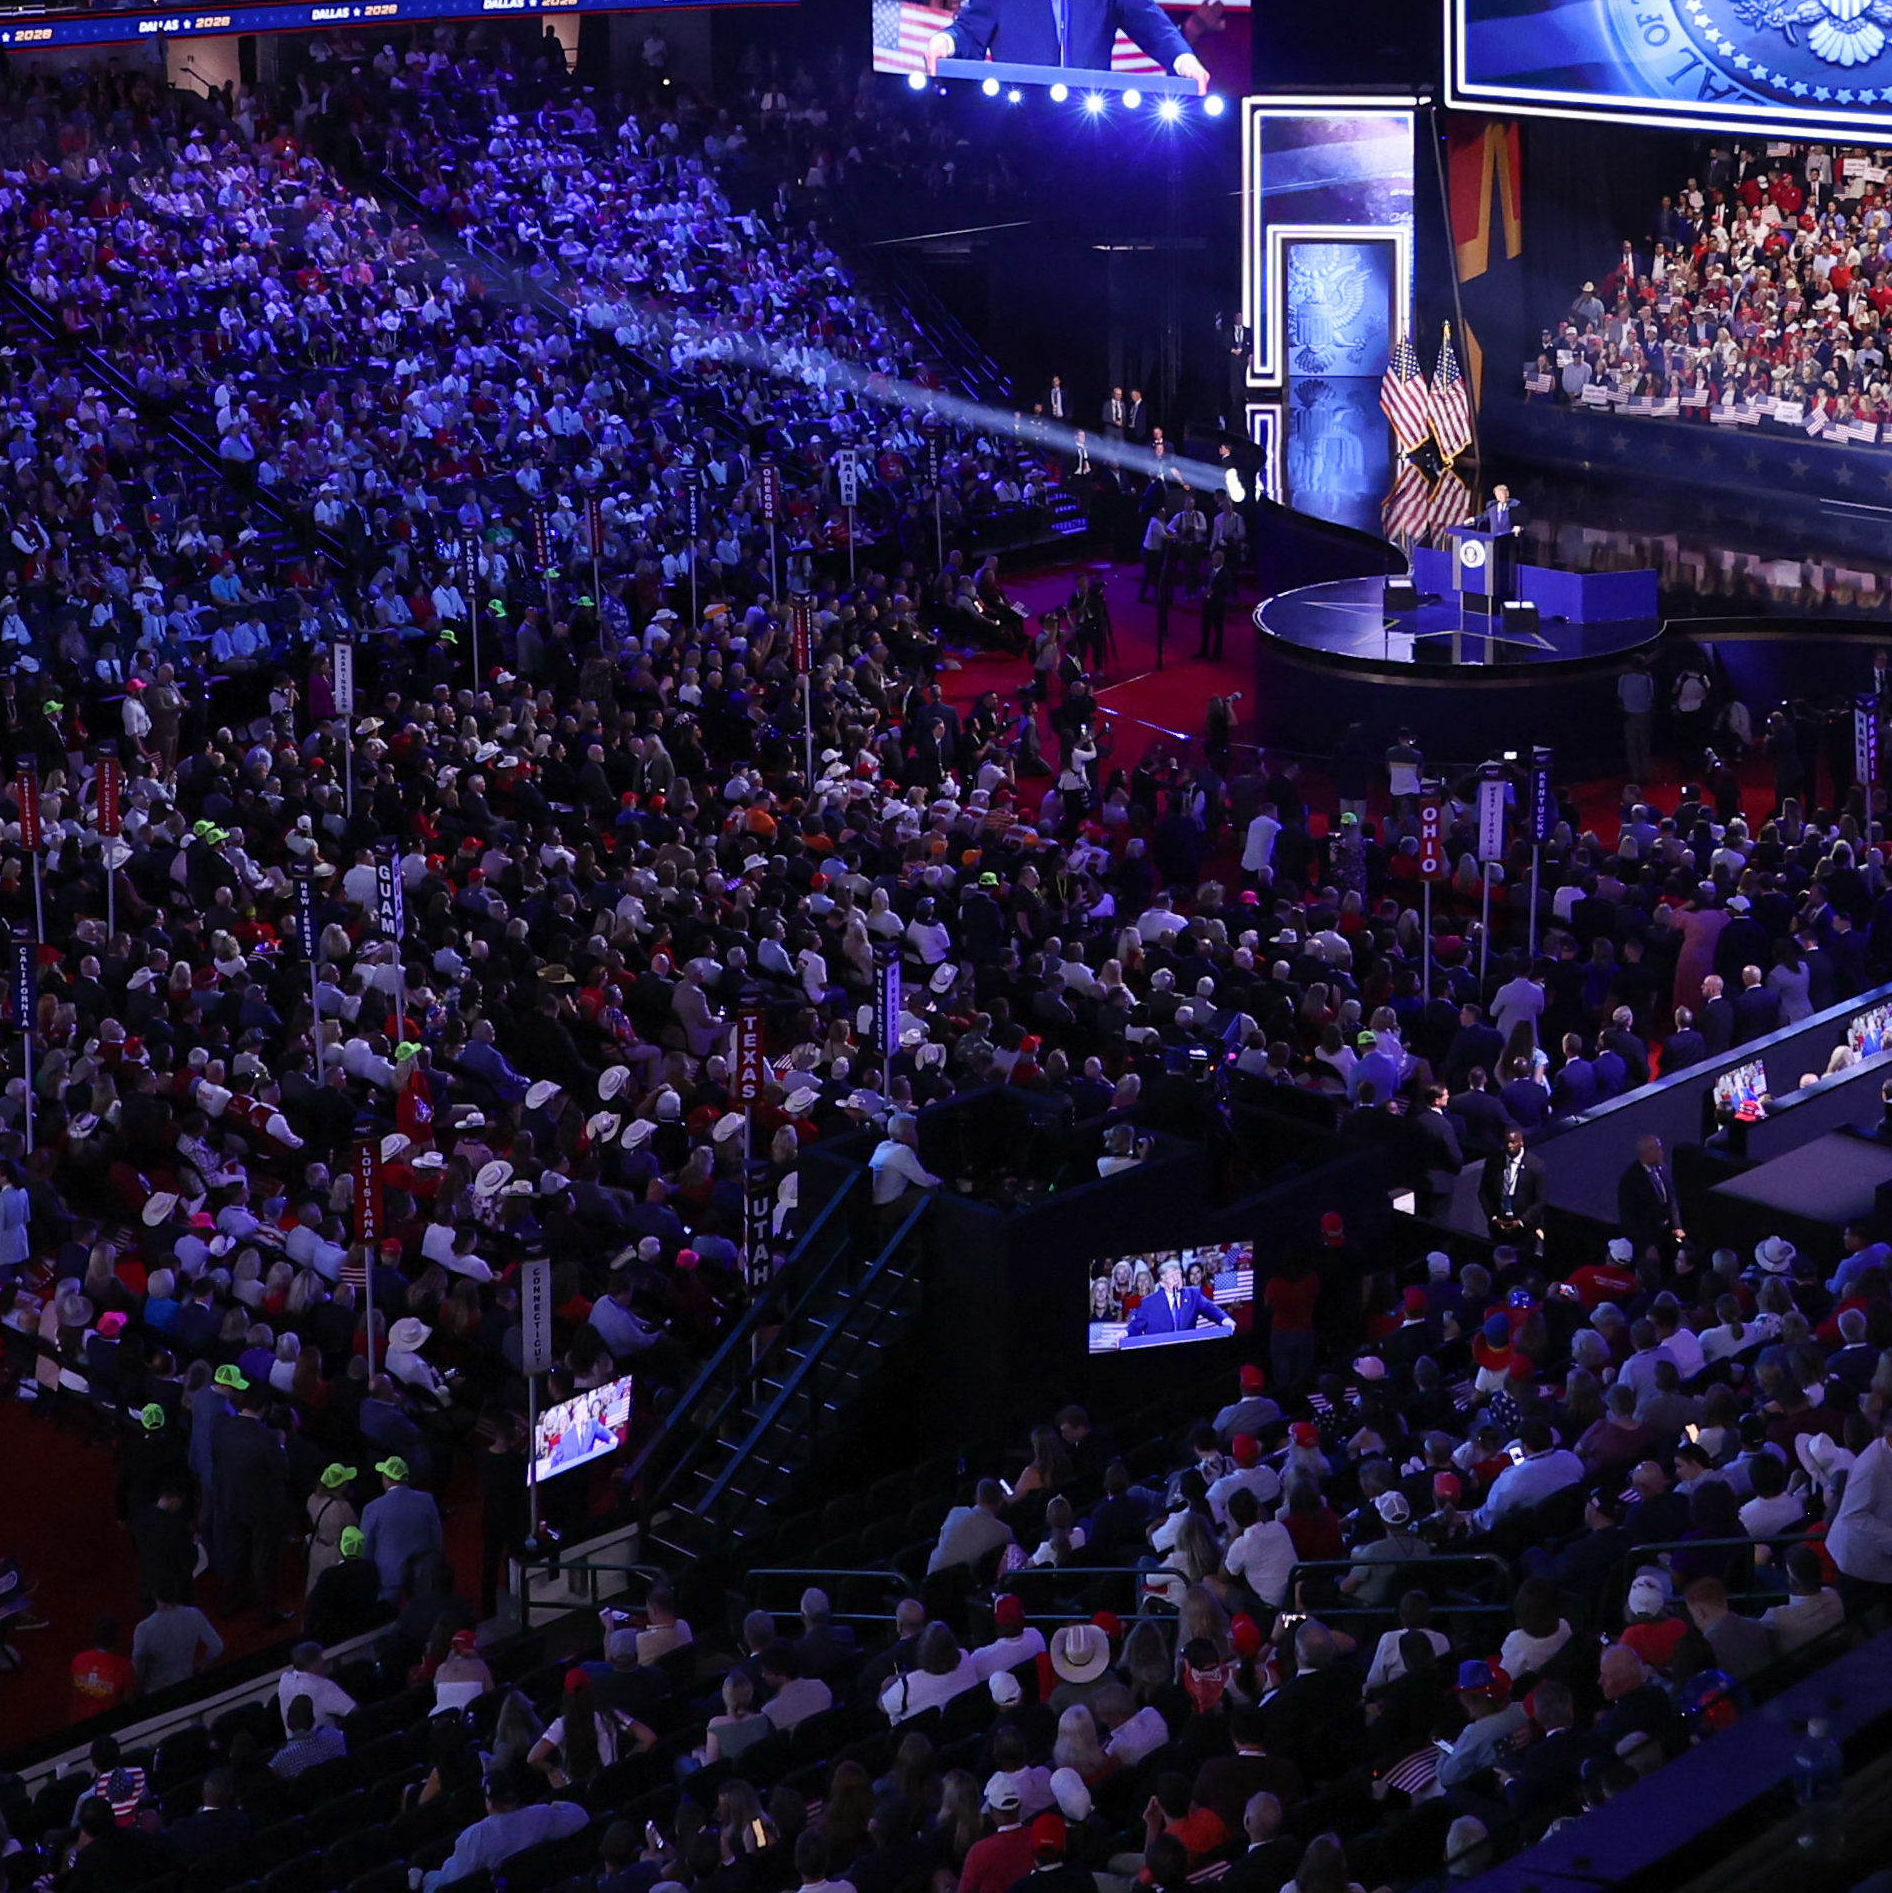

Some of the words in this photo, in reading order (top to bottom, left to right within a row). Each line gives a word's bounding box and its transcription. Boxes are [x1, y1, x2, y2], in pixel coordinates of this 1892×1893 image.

[14, 28, 53, 42] 2026
[195, 16, 231, 29] 2026
[311, 7, 350, 21] DALLAS
[364, 4, 399, 17] 2026
[1635, 12, 1671, 47] OF
[763, 468, 773, 518] OREGON
[843, 454, 853, 502] MAINE
[689, 485, 697, 536] WISCONSIN
[534, 512, 544, 564] NEVADA
[465, 540, 475, 594] FLORIDA
[1536, 771, 1547, 839] KENTUCKY
[1422, 807, 1437, 873] OHIO
[300, 882, 309, 906] NEW
[378, 865, 396, 934] GUAM
[304, 909, 312, 957] JERSEY
[19, 947, 29, 1027] CALIFORNIA
[743, 1016, 758, 1098] TEXAS
[362, 1146, 374, 1239] LOUISIANA
[753, 1197, 770, 1286] UTAH
[533, 1268, 541, 1363] CONNECTICUT
